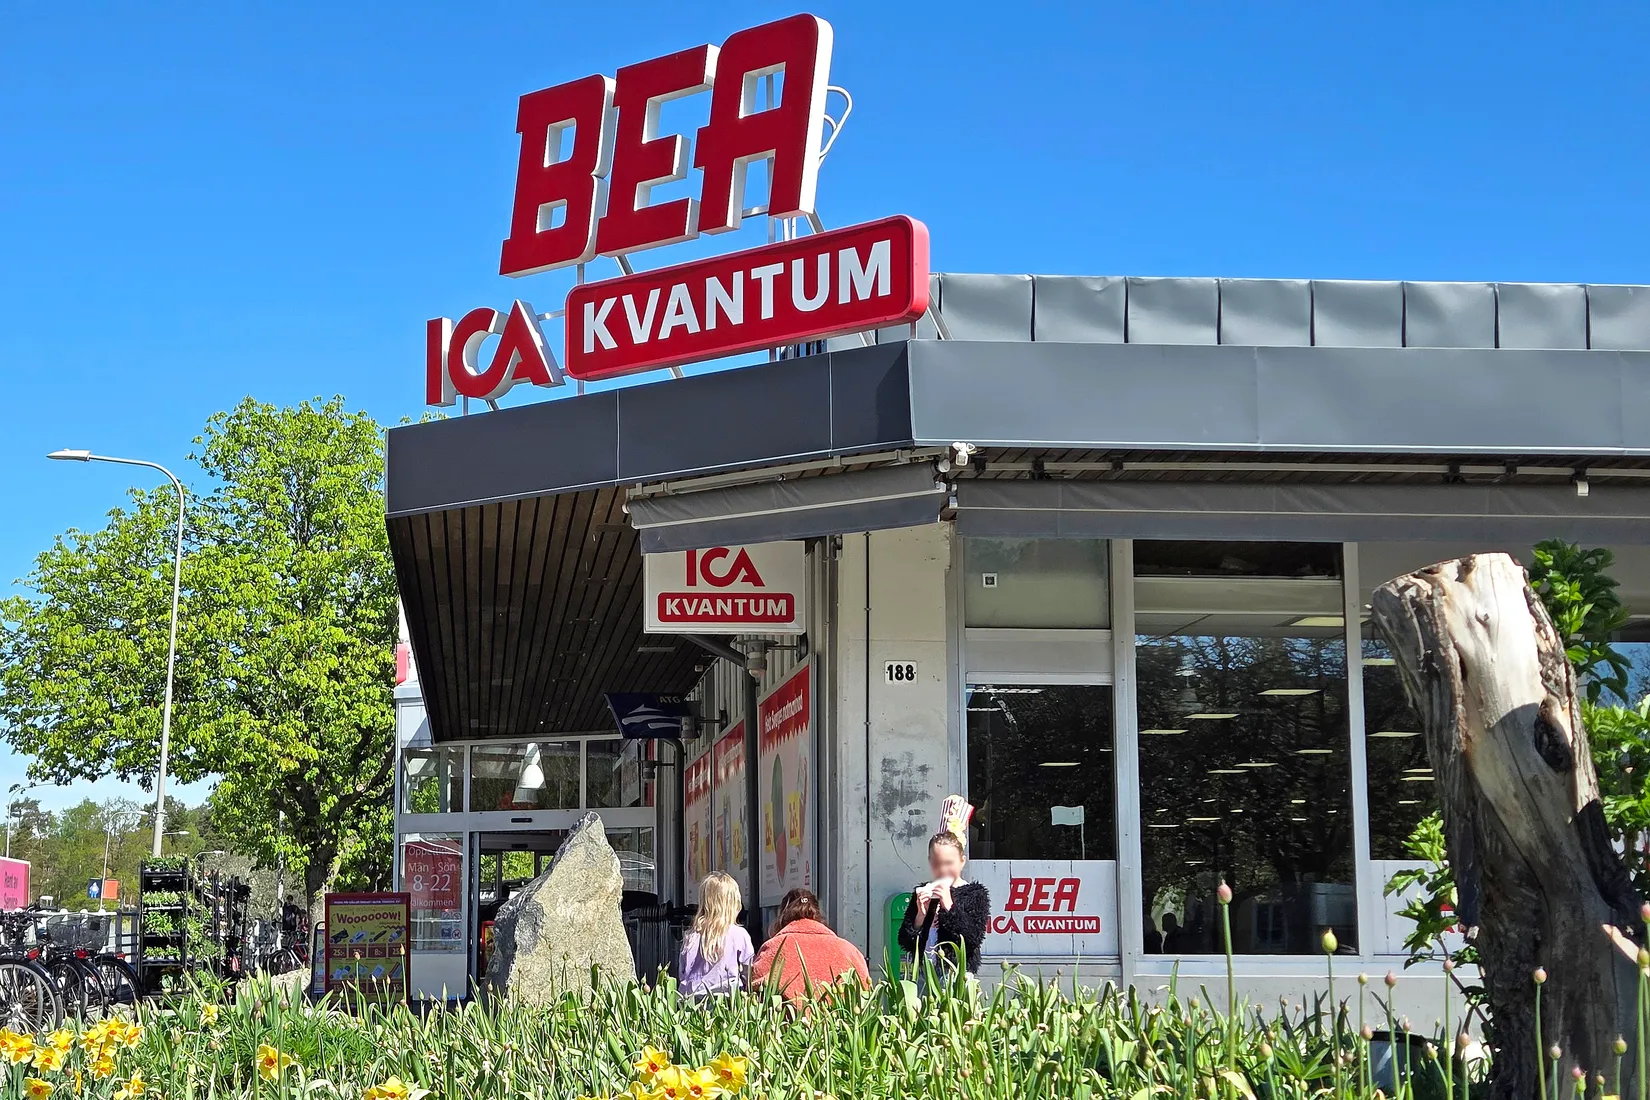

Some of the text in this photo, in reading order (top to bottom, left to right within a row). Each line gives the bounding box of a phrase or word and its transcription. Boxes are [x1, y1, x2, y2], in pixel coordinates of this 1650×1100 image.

[500, 13, 828, 277] BEA
[426, 239, 892, 405] ICA KVANTUM
[685, 547, 766, 588] ICA
[665, 598, 787, 616] KVANTUM
[887, 664, 915, 681] 188
[660, 696, 680, 704] ATG
[408, 862, 429, 873] Mån
[437, 861, 456, 873] Sön
[413, 874, 451, 892] 8-22
[1004, 878, 1081, 911] BEA
[1028, 920, 1097, 930] KVANTUM
